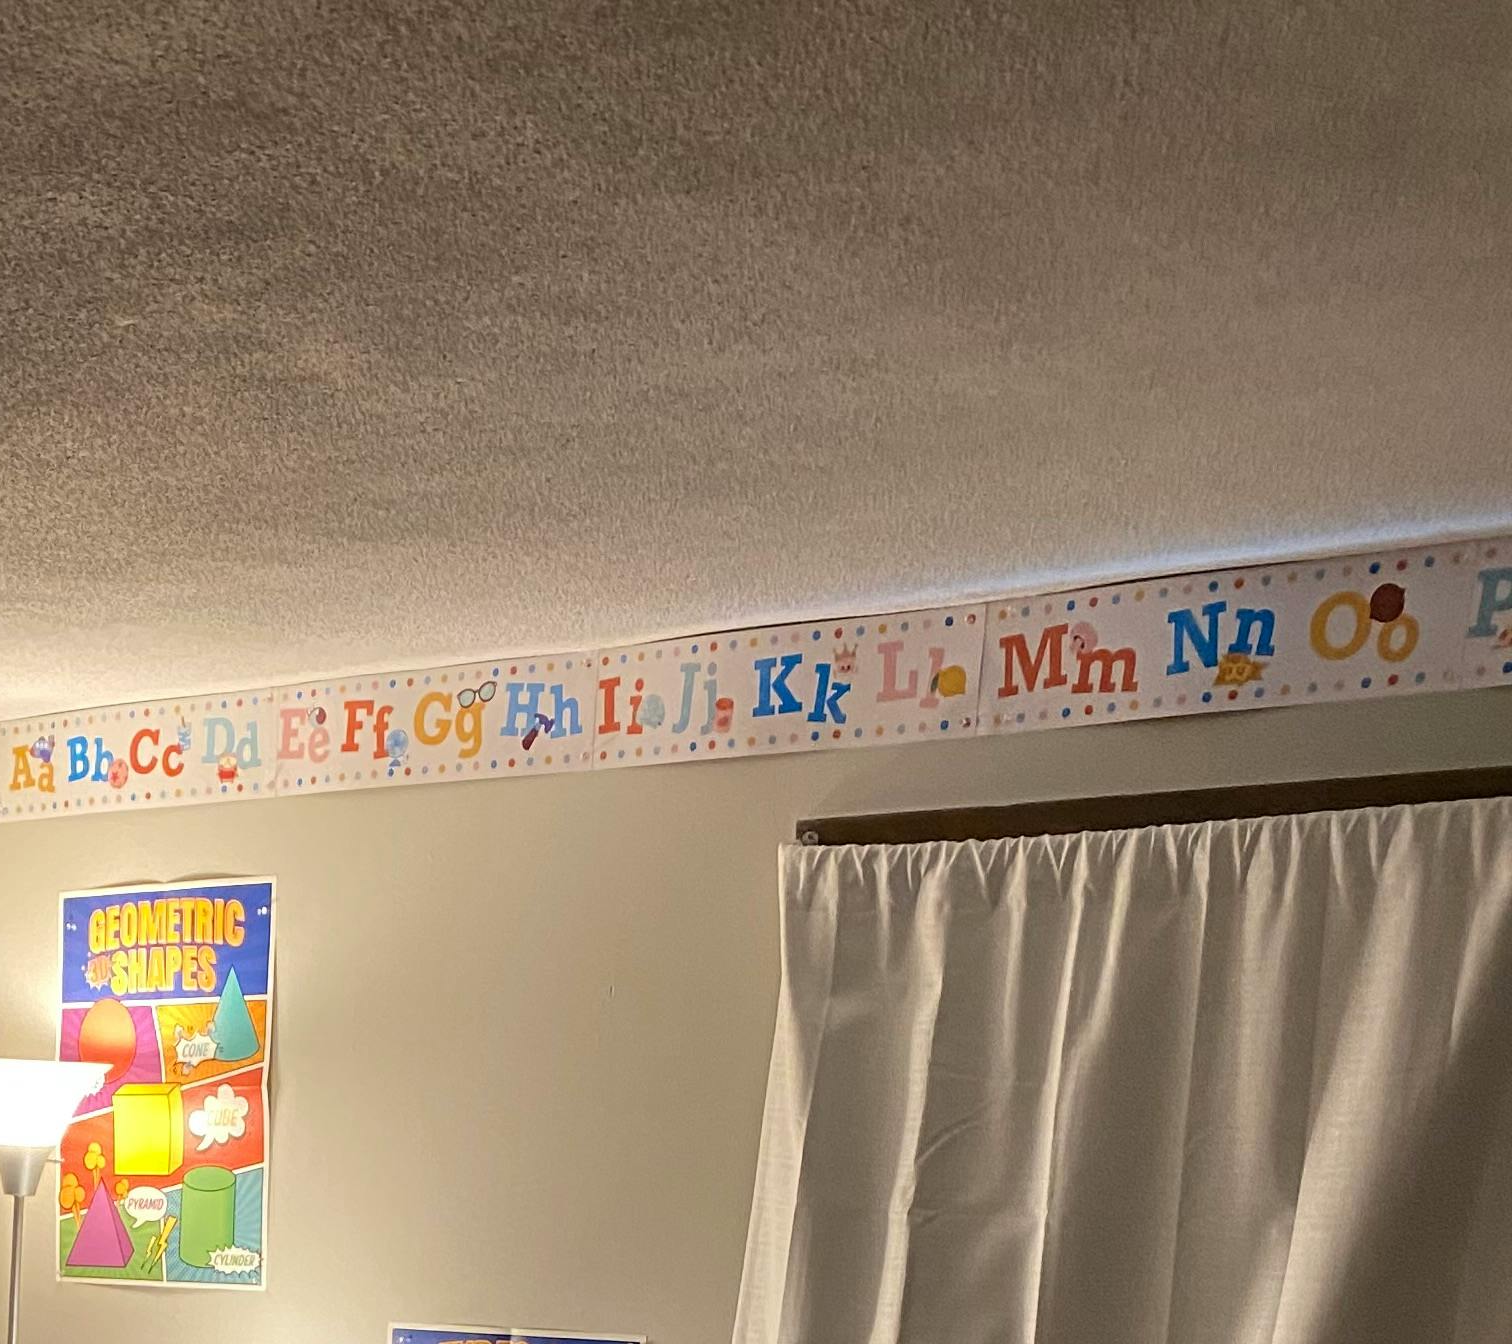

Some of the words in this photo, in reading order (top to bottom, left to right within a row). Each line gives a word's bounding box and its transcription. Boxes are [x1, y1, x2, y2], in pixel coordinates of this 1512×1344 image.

[9, 744, 56, 793] Aa
[66, 735, 115, 782] Bb
[129, 729, 185, 777] Cc
[201, 716, 262, 770] Dd
[277, 708, 332, 763] Ee
[341, 699, 394, 760] Ff
[413, 690, 488, 757] Gg
[499, 681, 582, 739] Hh
[598, 676, 644, 735] Ii
[752, 653, 852, 724] Kk
[997, 623, 1139, 699] Mm
[1166, 601, 1275, 676] Nn
[1309, 590, 1420, 663] Oo
[89, 899, 246, 954] GEOMETRIC
[111, 946, 217, 996] SHAPES
[181, 1041, 210, 1059] CONE
[127, 1196, 164, 1212] PYRAMID
[213, 1252, 256, 1268] CYLINDER
